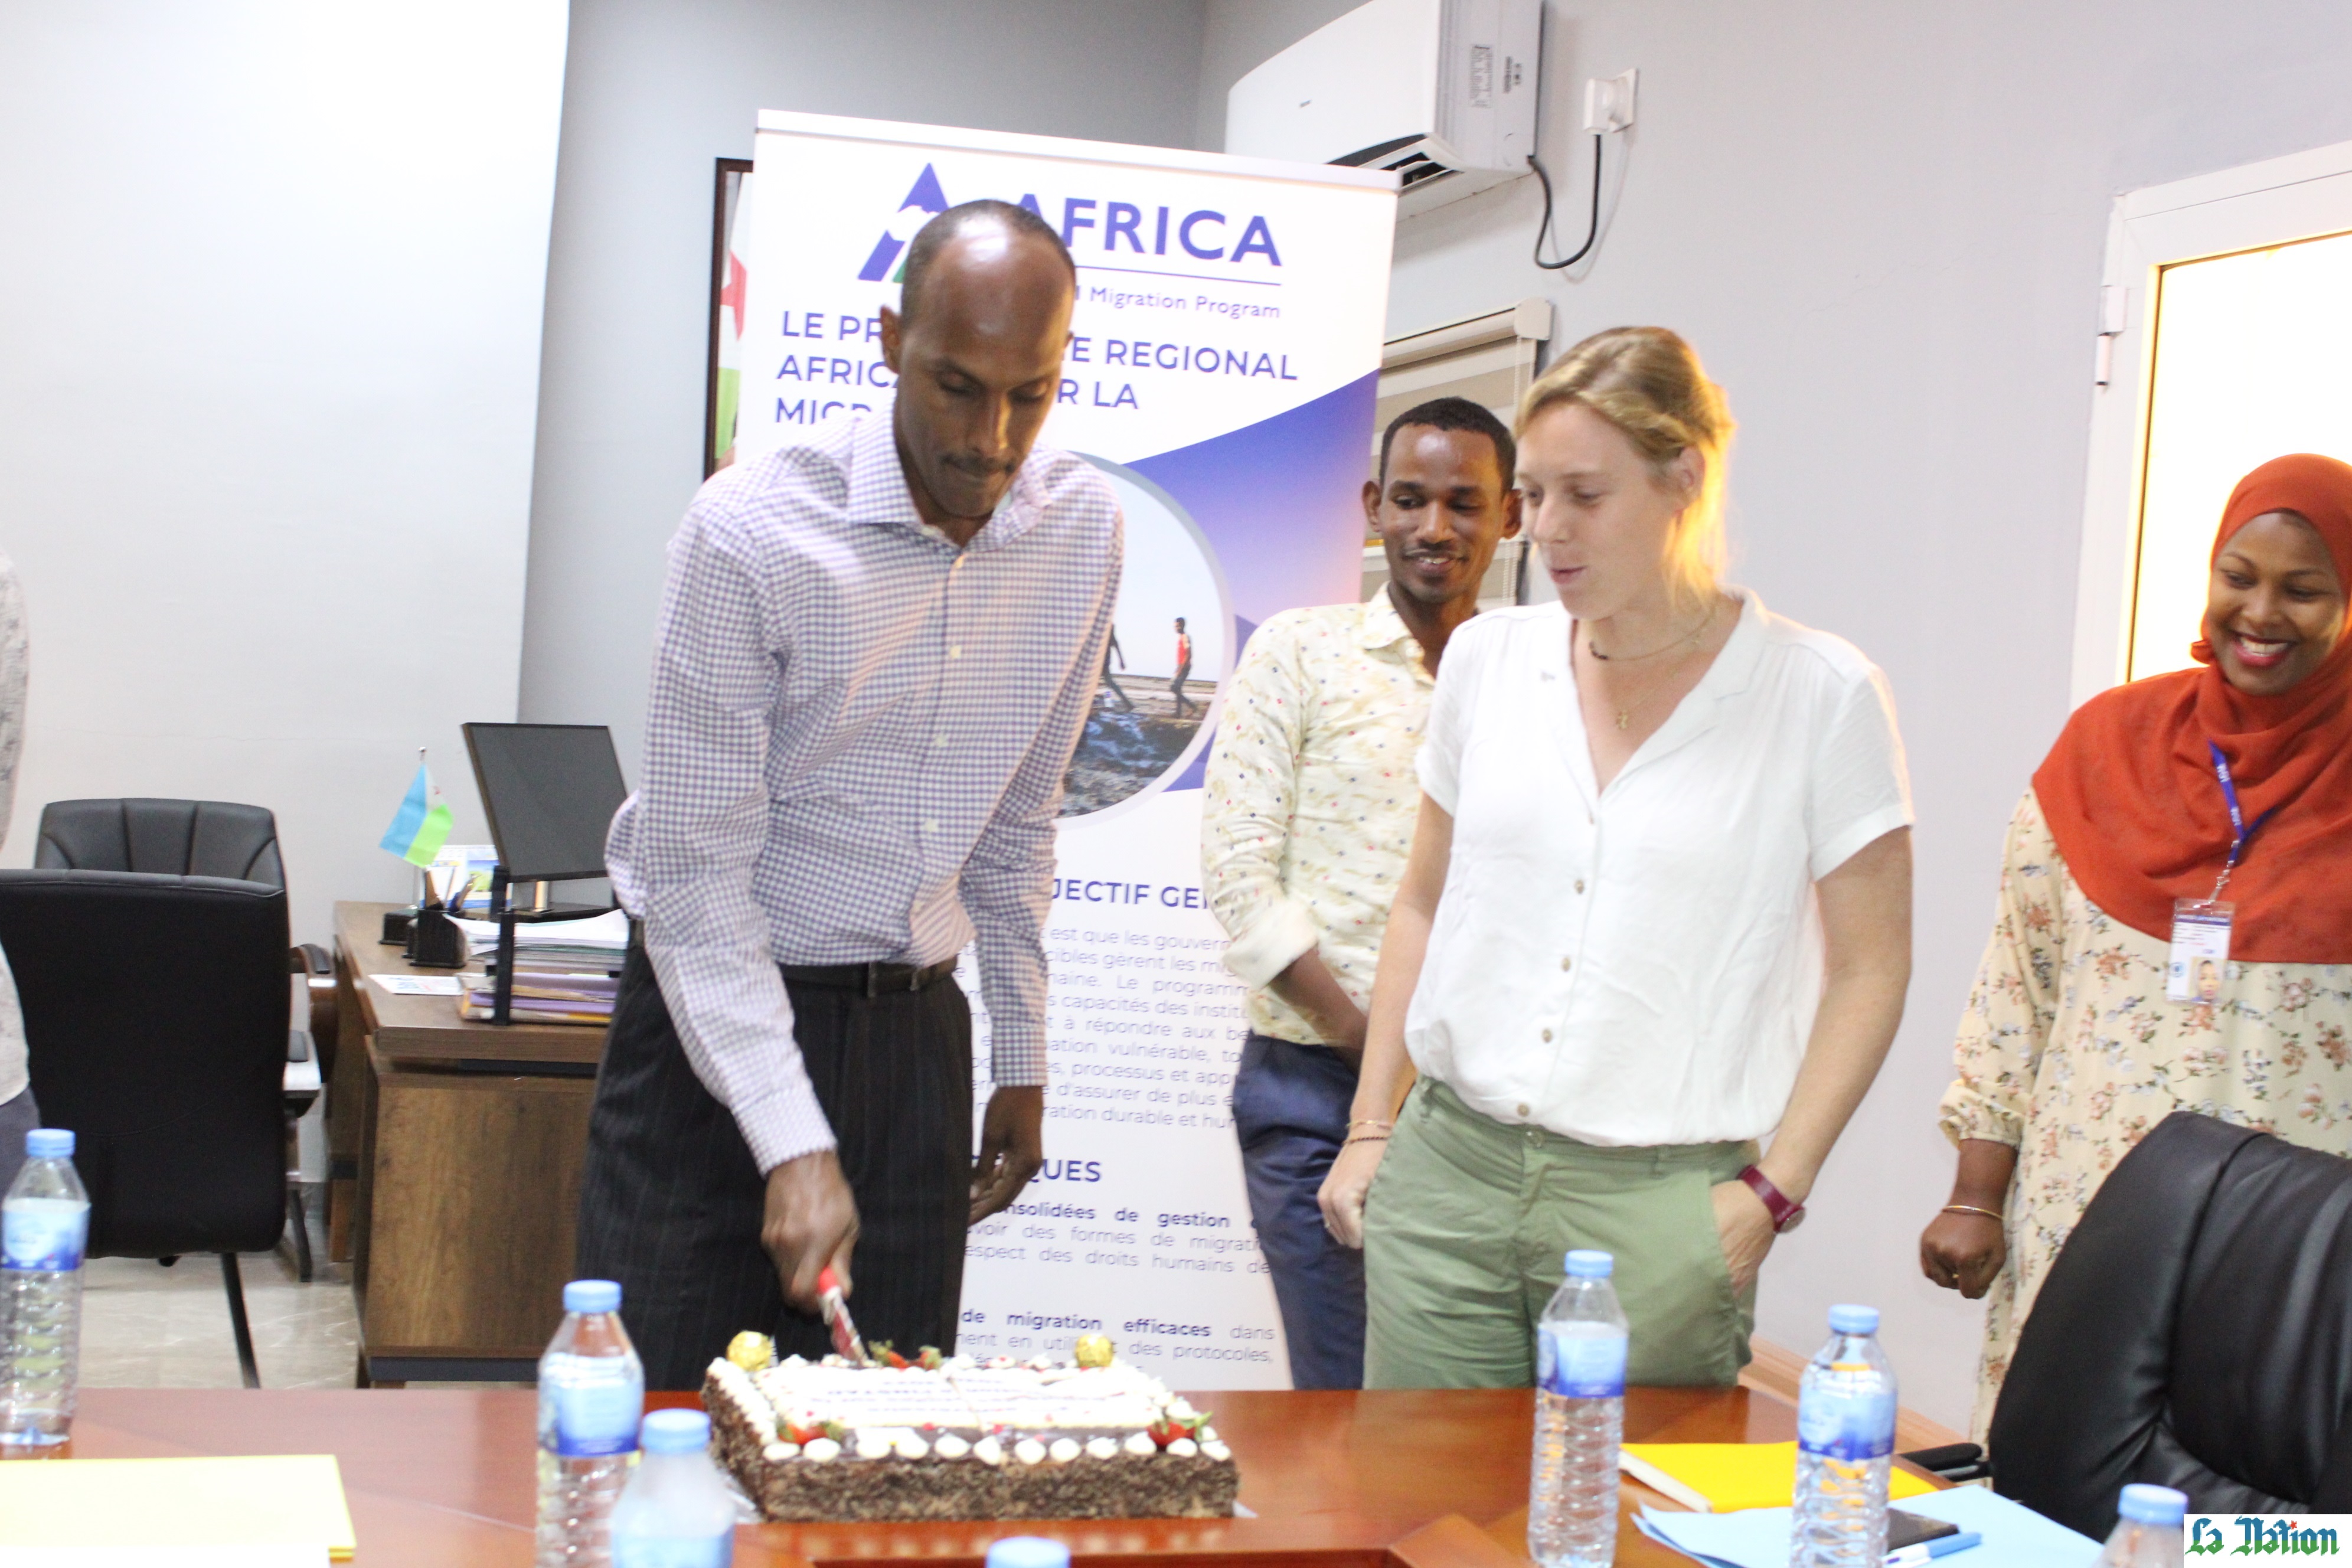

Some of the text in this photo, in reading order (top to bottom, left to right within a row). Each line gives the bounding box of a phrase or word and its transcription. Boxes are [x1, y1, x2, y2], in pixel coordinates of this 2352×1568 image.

[1090, 287, 1187, 309] Migration
[1195, 295, 1280, 320] Program
[782, 311, 825, 339] LE
[1105, 339, 1298, 381] REGIONAL
[776, 354, 897, 388] AFRIC
[1093, 381, 1139, 410] LA
[1051, 878, 1151, 904] JECTIF
[1050, 929, 1077, 941] est
[1083, 931, 1119, 946] que
[1124, 929, 1150, 946] les
[1154, 936, 1232, 951] gouvern
[1171, 955, 1196, 971] les
[1116, 975, 1139, 989] Le
[1152, 980, 1250, 997] programm
[1061, 996, 1150, 1013] capacités
[1155, 1000, 1189, 1015] des
[1086, 1017, 1172, 1037] répondre
[1181, 1026, 1216, 1039] aux
[1047, 1037, 1098, 1054] ation
[1072, 1064, 1165, 1080] processus
[1170, 1070, 1190, 1082] et
[1146, 1087, 1172, 1103] de
[1177, 1090, 1217, 1108] plus
[1101, 1106, 1174, 1126] durable
[1178, 1115, 1198, 1127] et
[1032, 1158, 1101, 1183] UES
[1005, 1201, 1230, 1229] nsolidées de gestion
[1022, 1223, 1057, 1239] des
[1070, 1226, 1136, 1244] formes
[1151, 1231, 1175, 1247] de
[965, 1245, 1027, 1261] espect
[1039, 1247, 1073, 1262] des
[1085, 1246, 1139, 1267] droits
[1152, 1253, 1235, 1273] humains
[961, 1308, 1276, 1340] de migration efficaces dans
[1007, 1337, 1033, 1349] en
[1129, 1340, 1163, 1356] des
[1172, 1345, 1274, 1364] protocoles,
